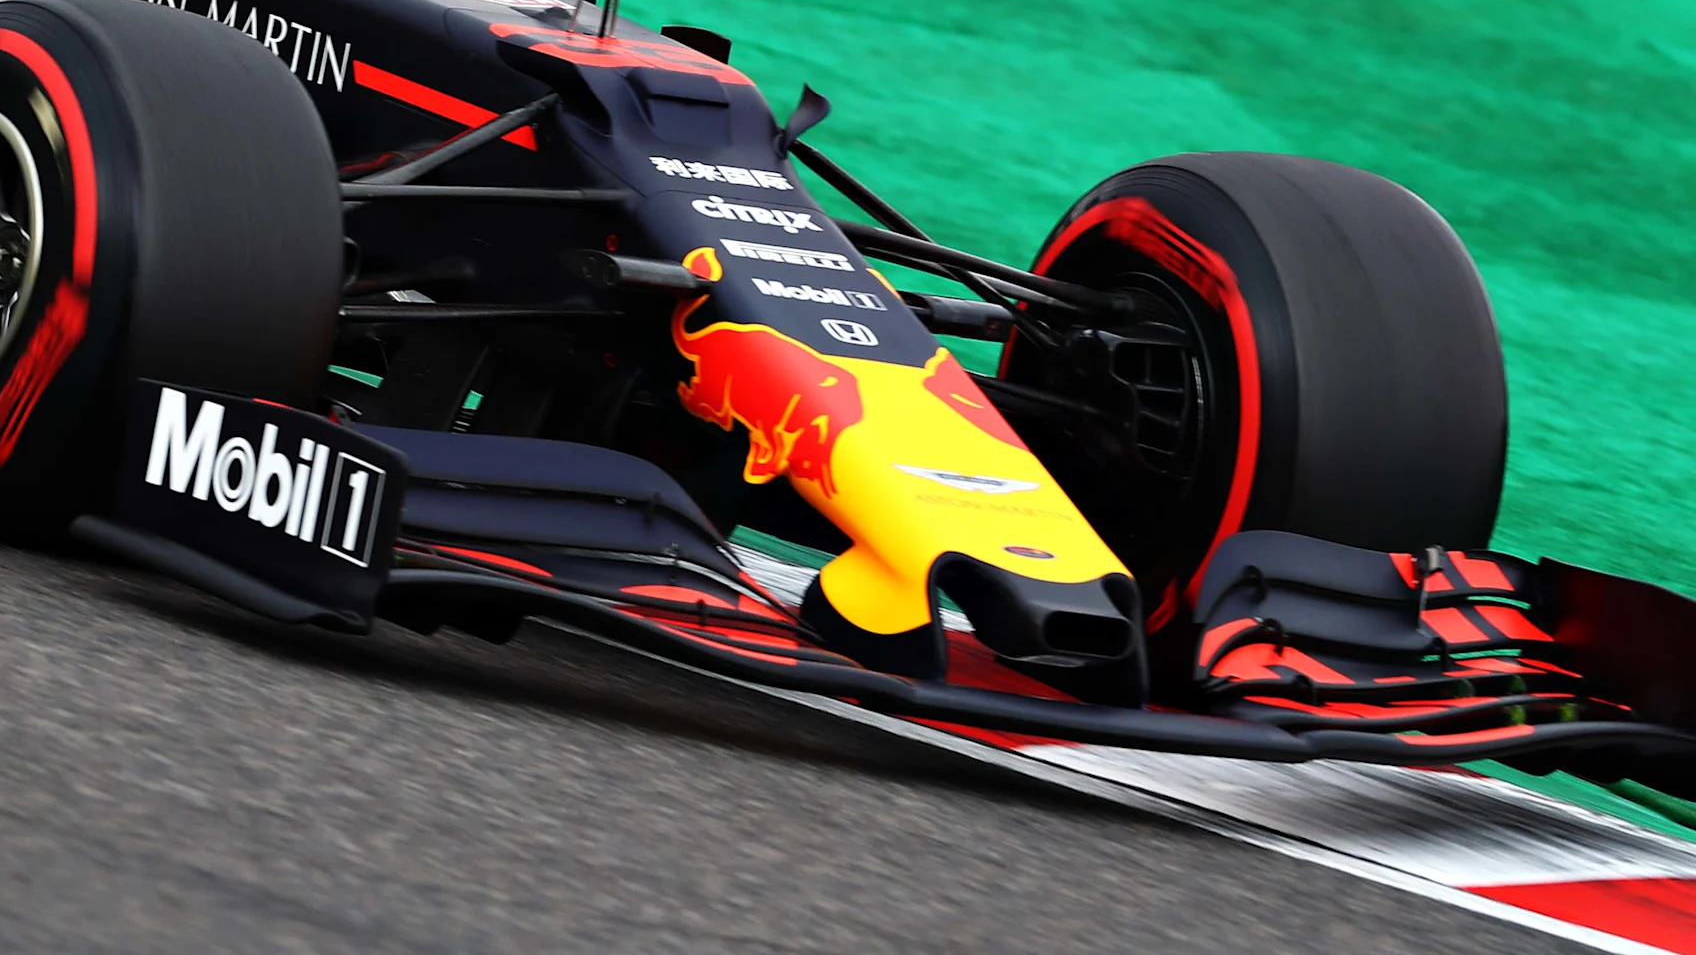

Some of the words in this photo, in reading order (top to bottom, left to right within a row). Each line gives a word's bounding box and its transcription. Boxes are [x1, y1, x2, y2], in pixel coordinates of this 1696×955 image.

[719, 239, 855, 272] PIRELLI
[752, 277, 851, 307] Mobil
[145, 387, 330, 543] Mobil
